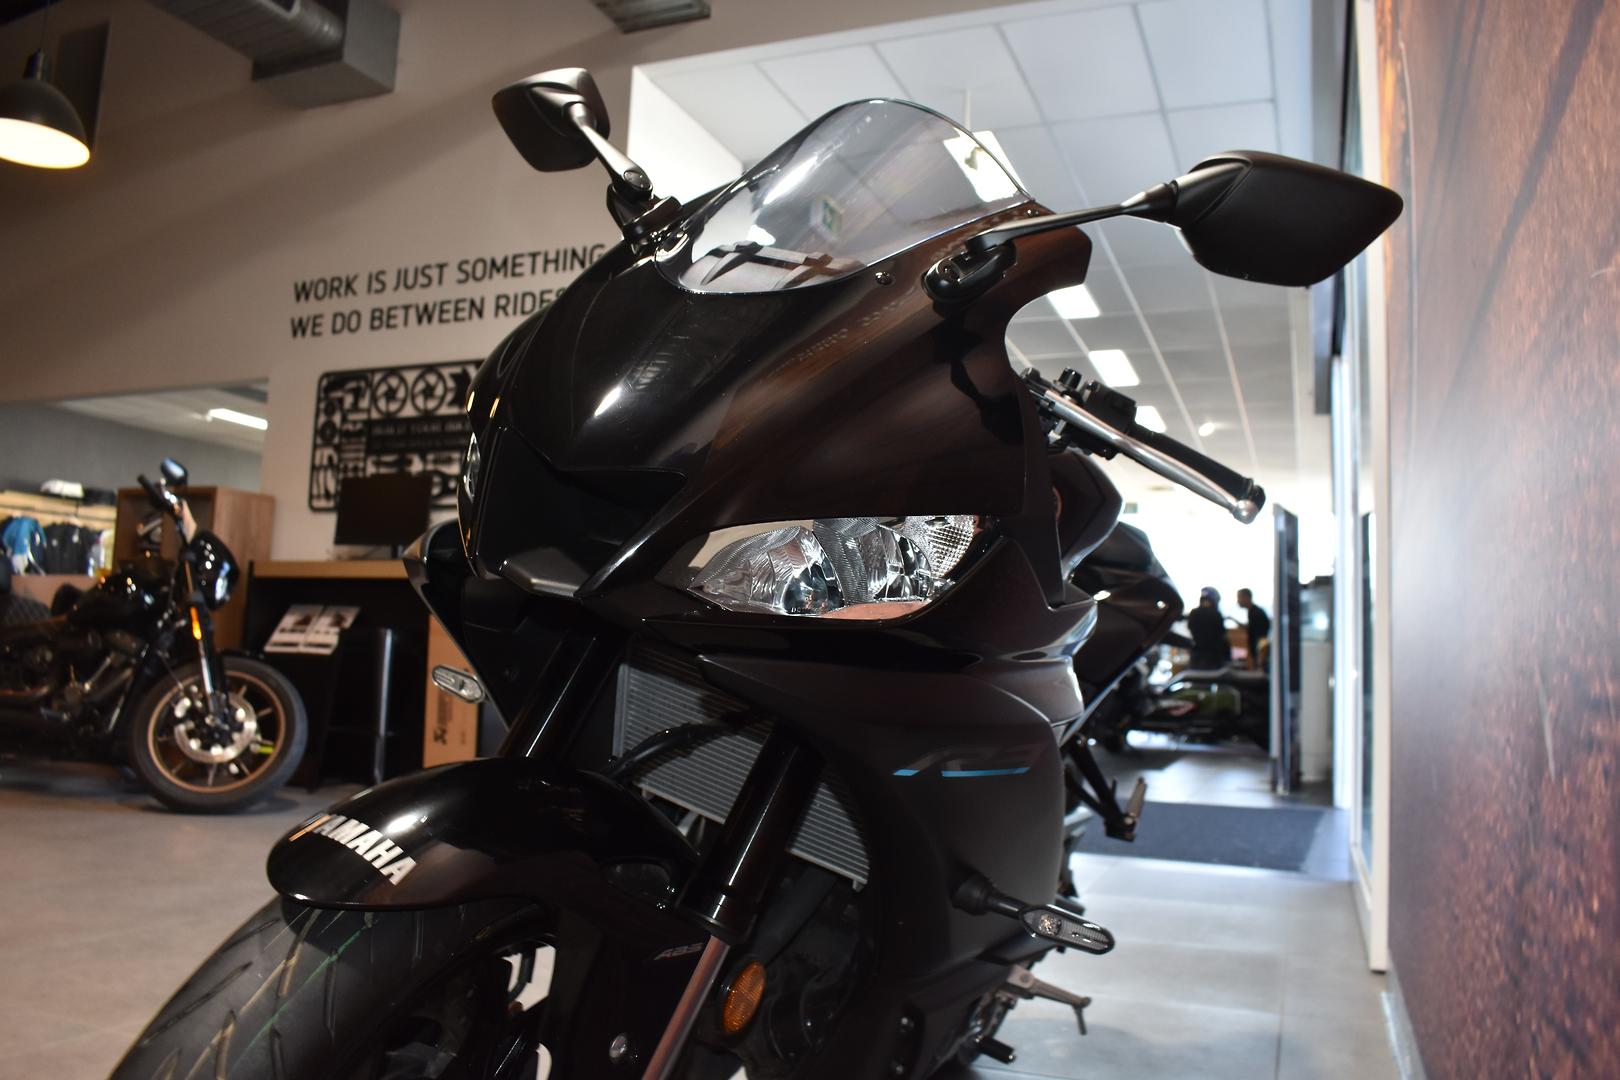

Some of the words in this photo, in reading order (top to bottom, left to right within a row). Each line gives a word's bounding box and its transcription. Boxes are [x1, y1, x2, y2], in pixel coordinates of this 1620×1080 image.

[293, 274, 358, 304] WORK
[366, 270, 387, 294] IS
[393, 262, 449, 292] JUST
[456, 243, 606, 285] SOMETHING
[289, 313, 323, 339] WE
[331, 310, 361, 335] DO
[369, 296, 485, 332] BETWEEN
[308, 812, 416, 886] AMAHA
